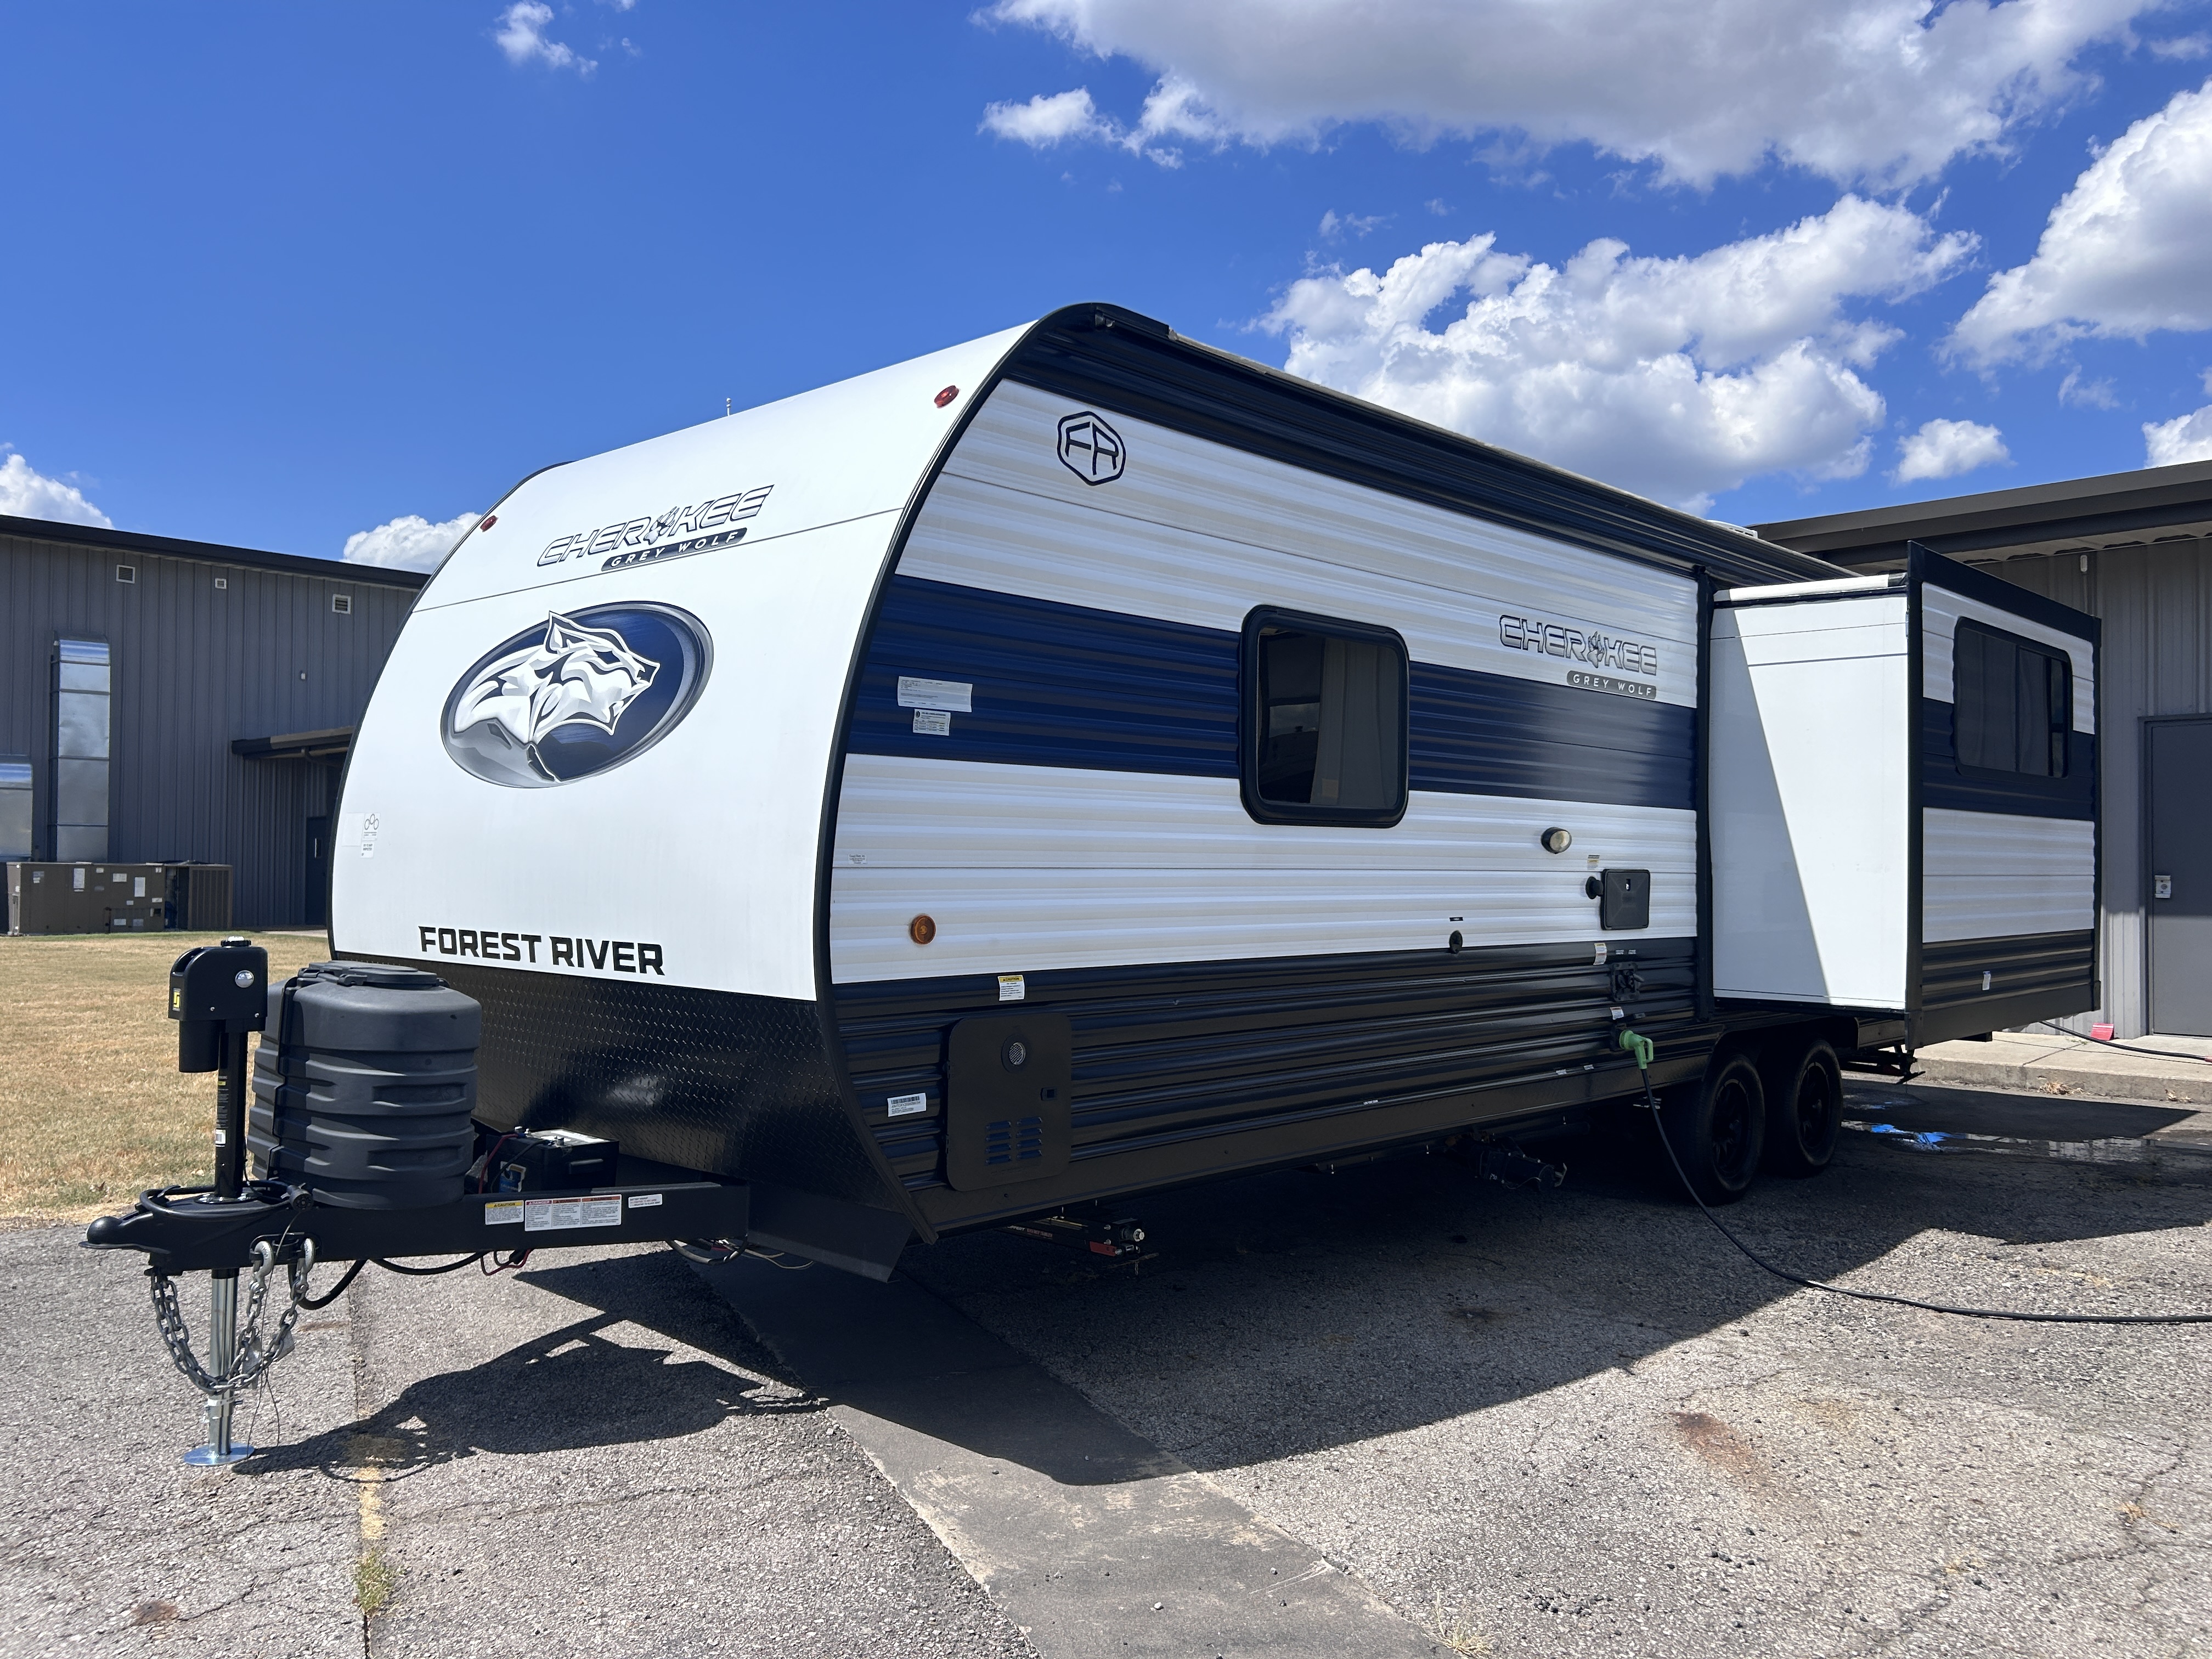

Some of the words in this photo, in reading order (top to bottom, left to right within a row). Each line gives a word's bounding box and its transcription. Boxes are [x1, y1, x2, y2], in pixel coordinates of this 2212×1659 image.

[610, 548, 665, 567] GREY
[678, 531, 738, 554] WOLF
[1572, 674, 1609, 689] GREY
[1617, 682, 1652, 697] WOLF
[418, 926, 542, 963] FOREST
[549, 936, 665, 975] RIVER
